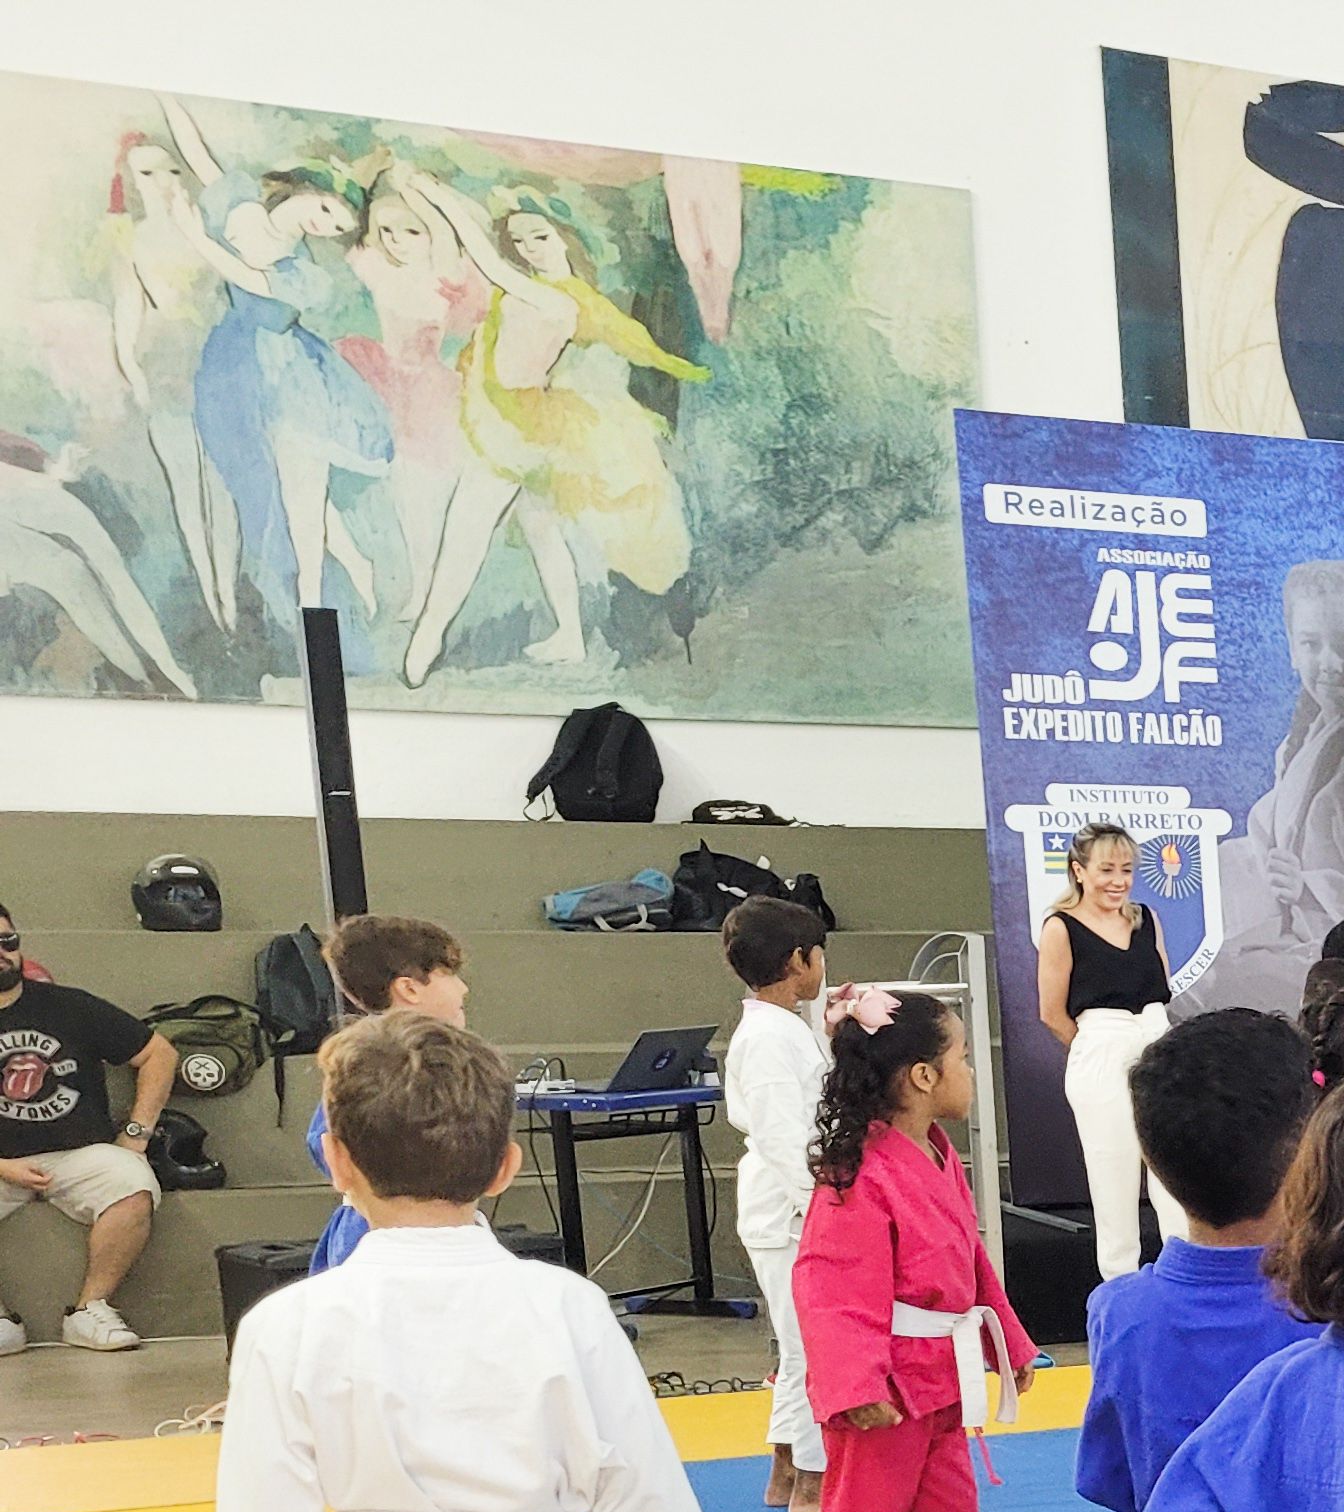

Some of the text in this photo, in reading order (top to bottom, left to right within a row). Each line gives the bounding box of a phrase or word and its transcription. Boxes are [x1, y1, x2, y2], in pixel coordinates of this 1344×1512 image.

[1003, 490, 1188, 528] Realização
[1096, 547, 1211, 570] ASSOCIAÇÃO
[1001, 670, 1085, 704] JUDÔ
[1002, 706, 1223, 747] EXPEDITO FALCÃO
[1069, 788, 1169, 805] INSTITUTO
[1038, 811, 1091, 828] DOM
[0, 1033, 52, 1054] LLING
[0, 1093, 71, 1119] STONES
